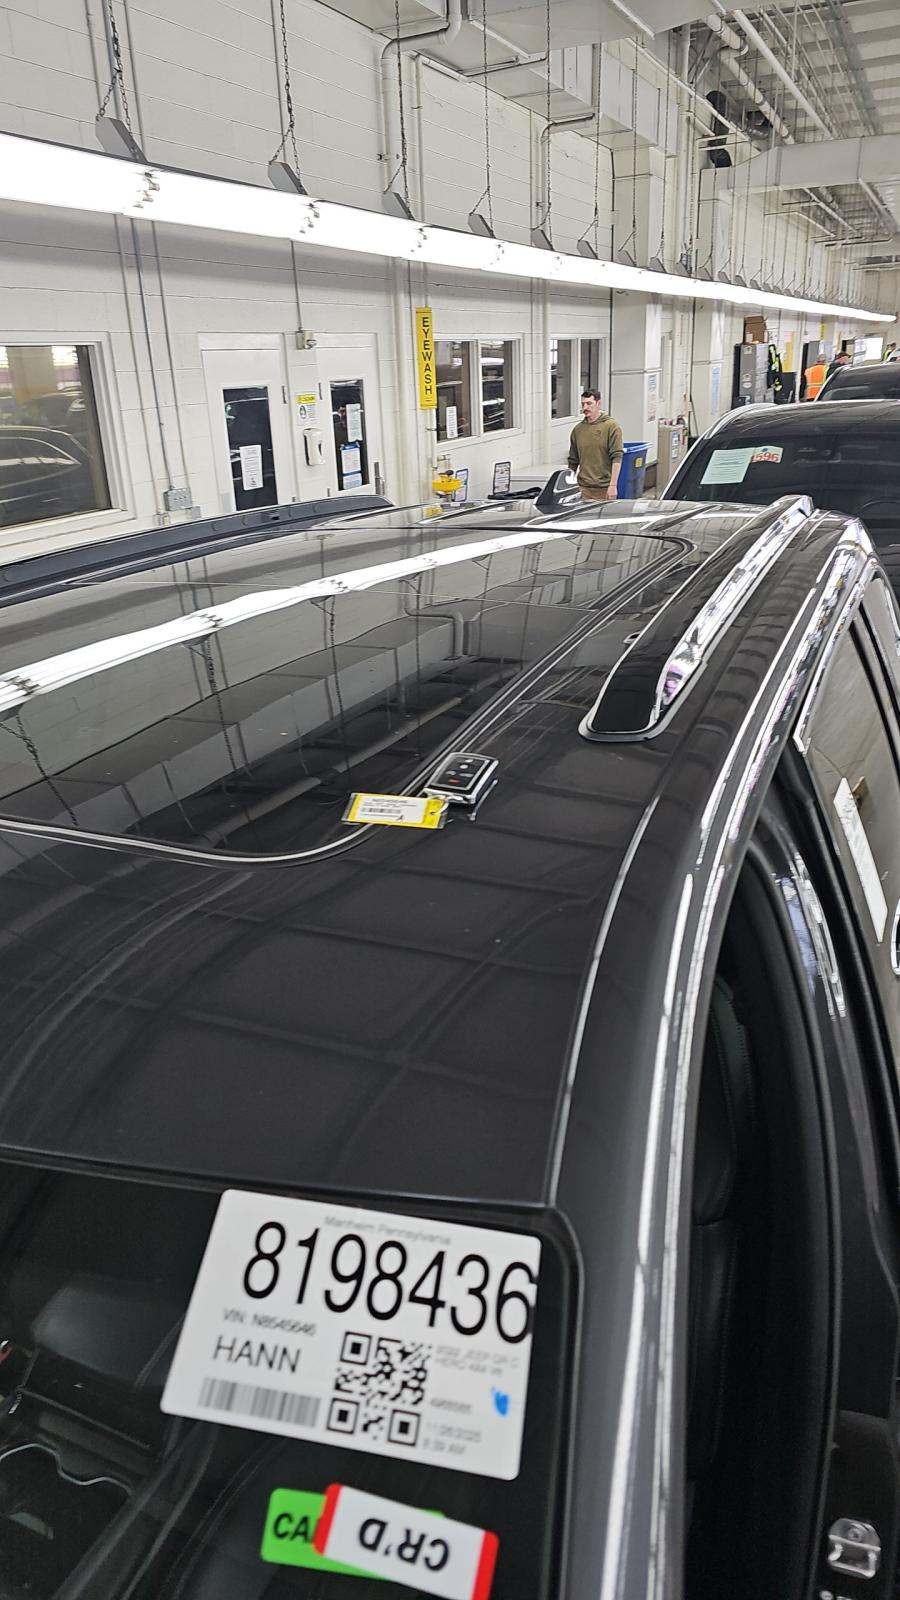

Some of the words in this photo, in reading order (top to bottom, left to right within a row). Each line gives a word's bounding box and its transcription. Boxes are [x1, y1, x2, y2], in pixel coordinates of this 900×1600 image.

[422, 316, 433, 396] EYEWASH
[243, 1221, 538, 1344] 8198436
[213, 1334, 301, 1374] HANN
[359, 1517, 450, 1572] CR'D
